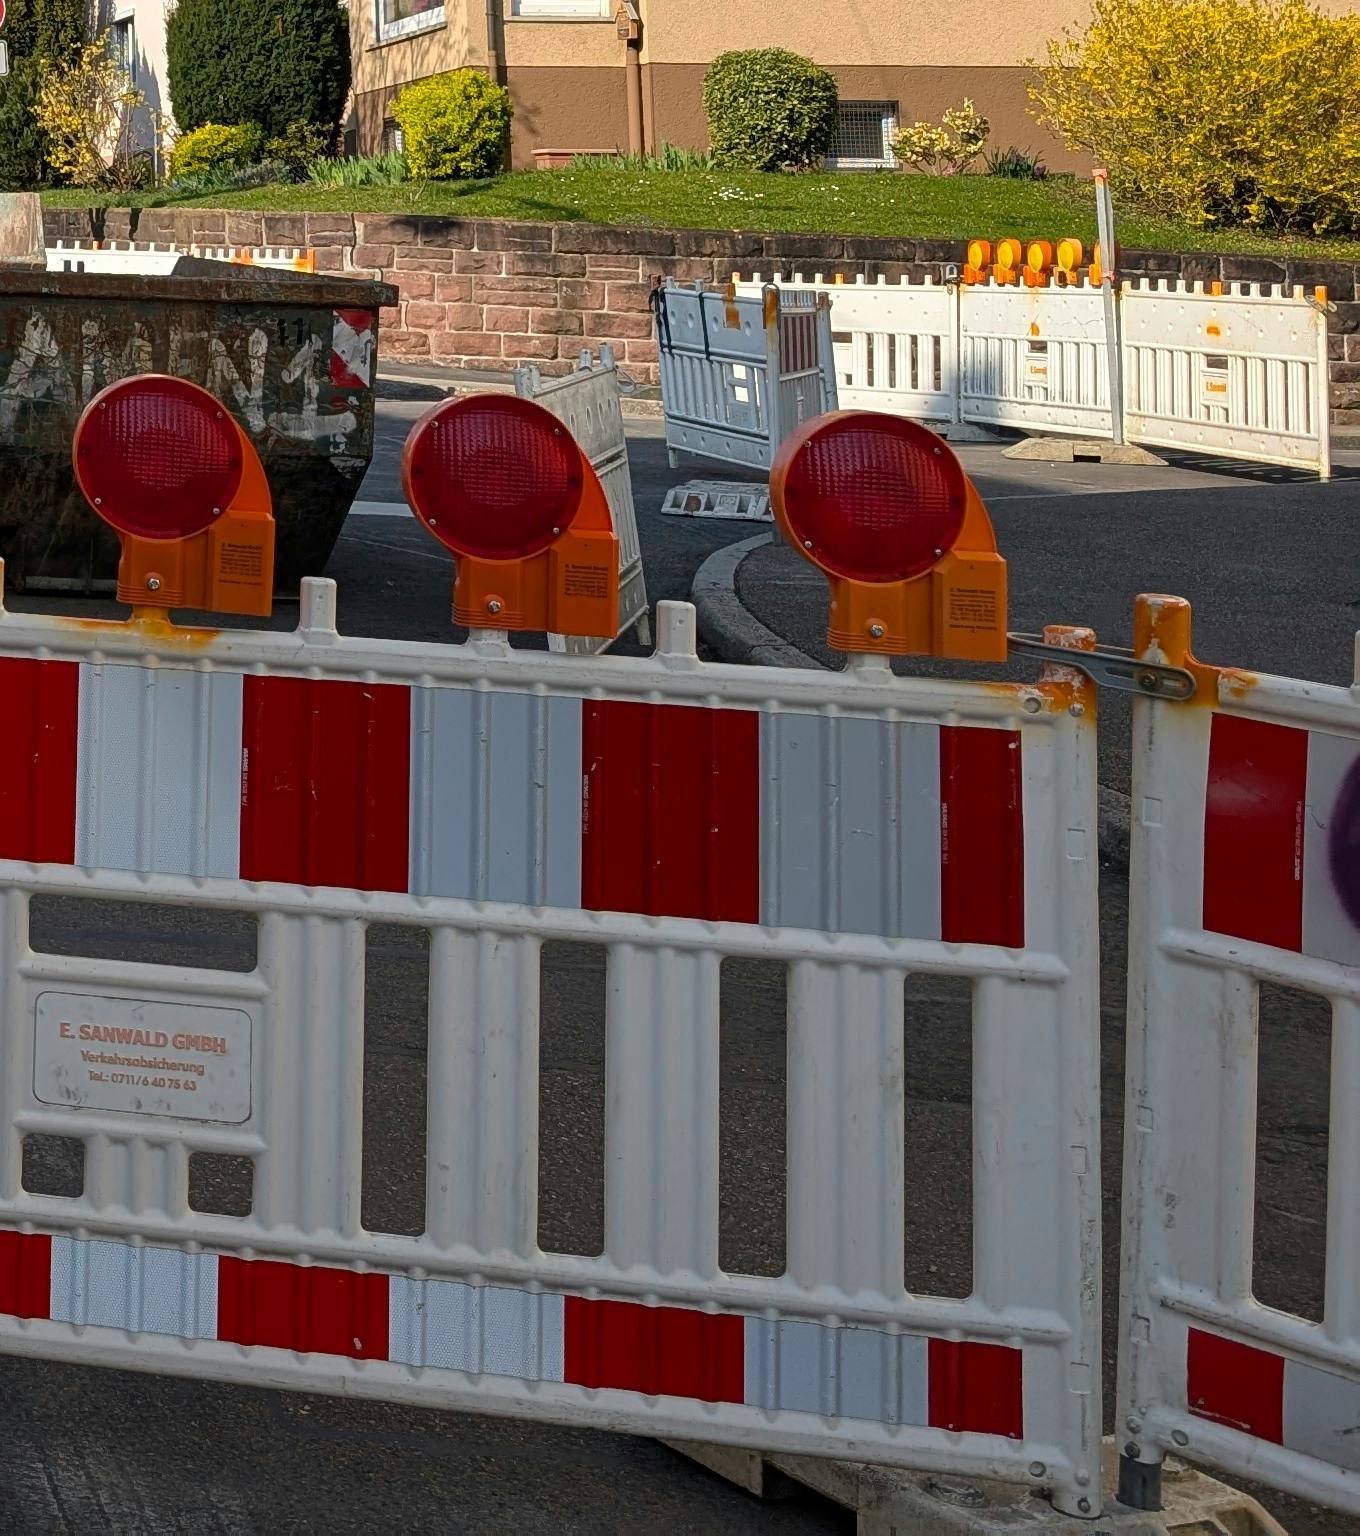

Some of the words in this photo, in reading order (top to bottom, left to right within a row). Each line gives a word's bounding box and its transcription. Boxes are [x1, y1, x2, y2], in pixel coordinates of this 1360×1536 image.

[59, 1022, 76, 1039] E.
[79, 1024, 169, 1048] SANWALD
[172, 1033, 227, 1054] GMBH
[80, 1049, 206, 1076] Verkehrsabsicherung
[88, 1069, 109, 1082] Tel.:
[168, 1078, 181, 1090] 75
[183, 1079, 197, 1092] 63
